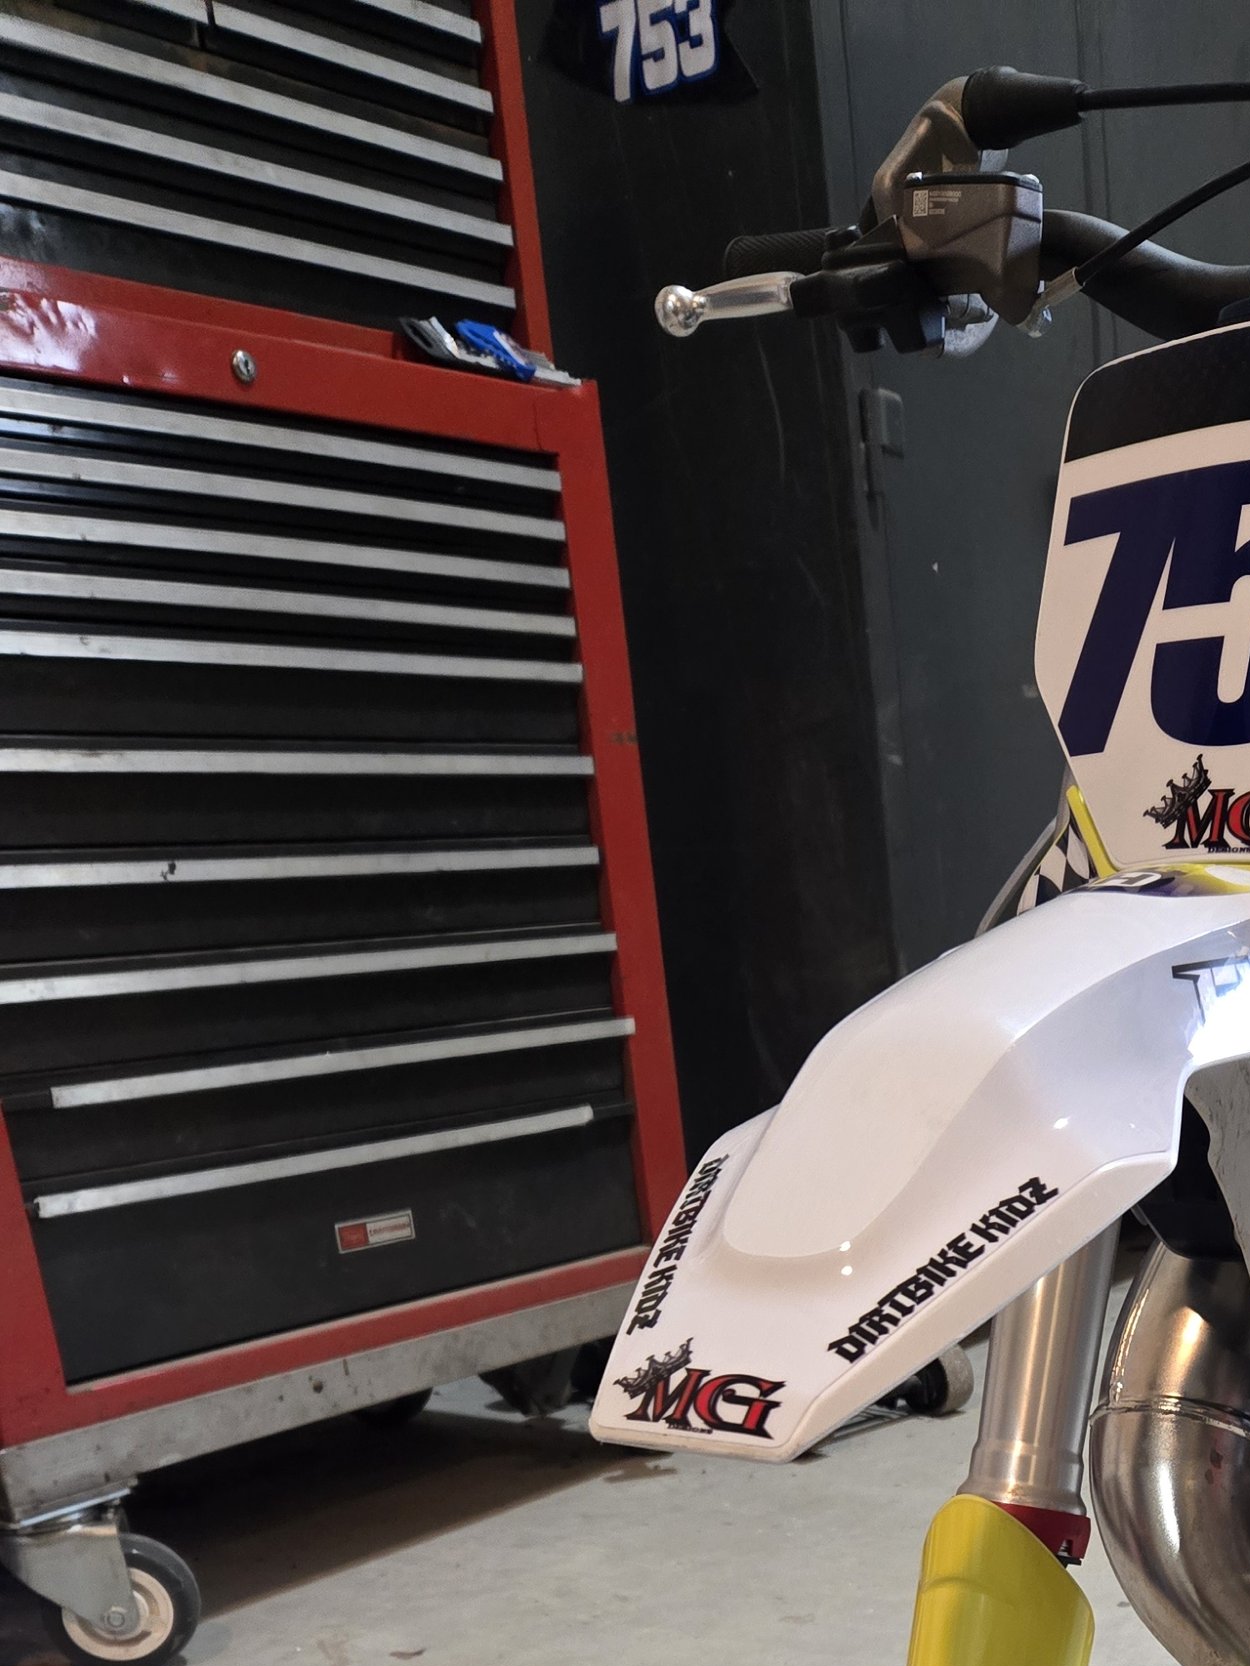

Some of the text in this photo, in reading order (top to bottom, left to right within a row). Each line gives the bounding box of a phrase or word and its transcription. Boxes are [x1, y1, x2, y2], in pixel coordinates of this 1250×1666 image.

[599, 0, 718, 102] 753
[626, 1264, 678, 1336] KIDZ
[827, 1176, 1059, 1364] DIRTBIKE KIDZ
[624, 1367, 787, 1440] MG
